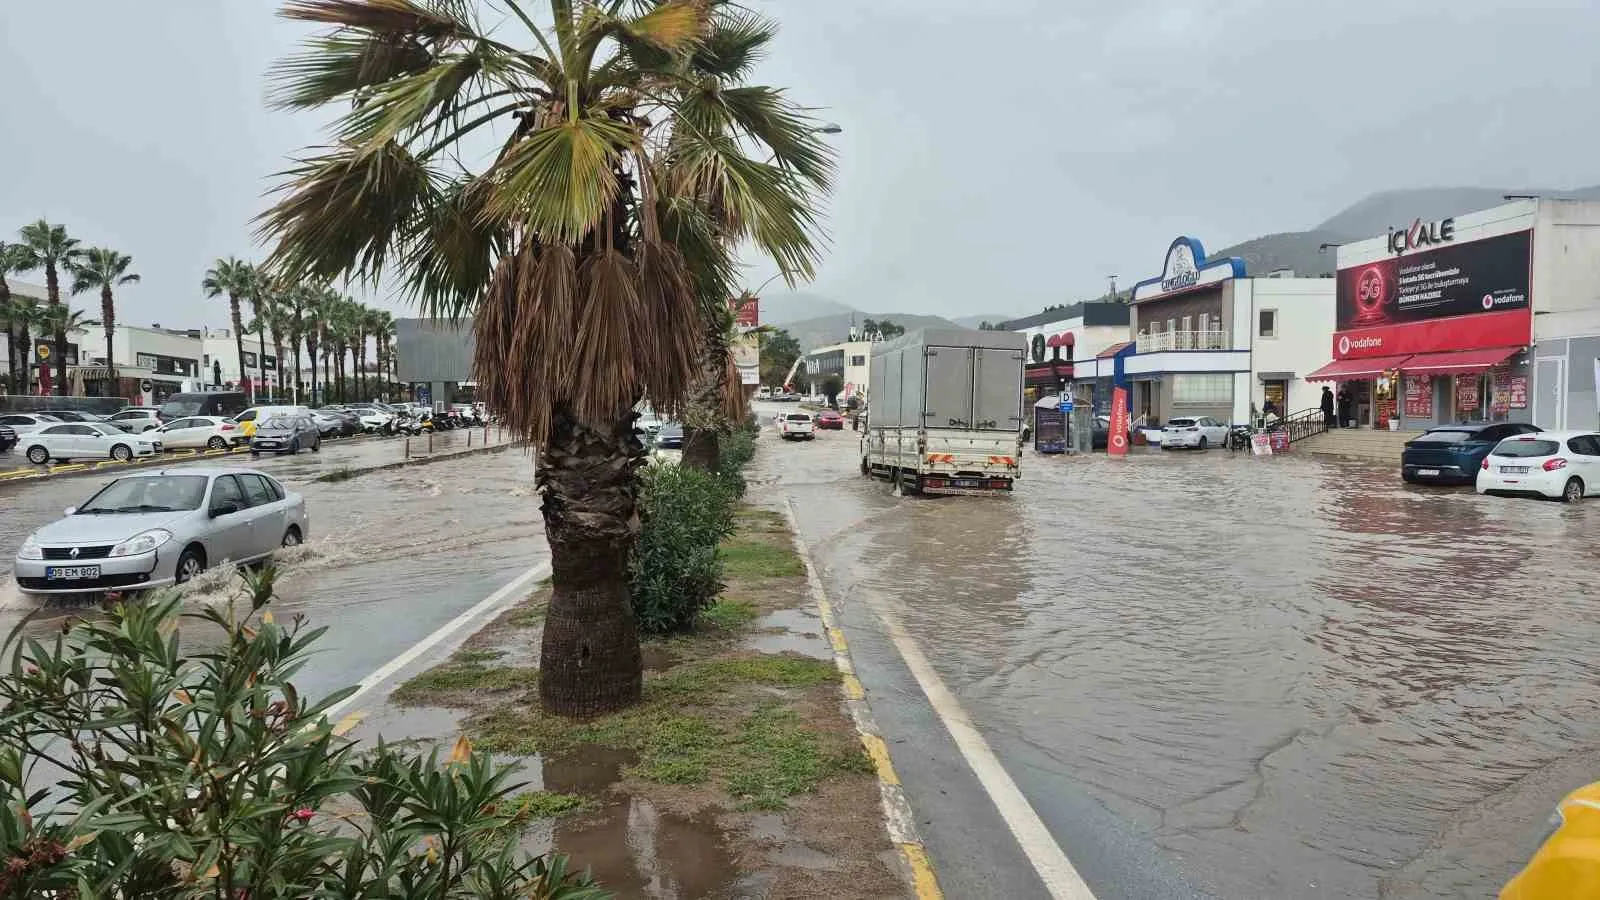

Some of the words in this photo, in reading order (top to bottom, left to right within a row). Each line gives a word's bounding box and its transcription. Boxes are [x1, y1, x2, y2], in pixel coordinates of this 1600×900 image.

[1388, 217, 1454, 256] İÇKALE
[1361, 279, 1380, 299] 5G
[1495, 294, 1524, 304] vodafone
[1350, 337, 1382, 349] vodafone
[1064, 393, 1070, 402] D
